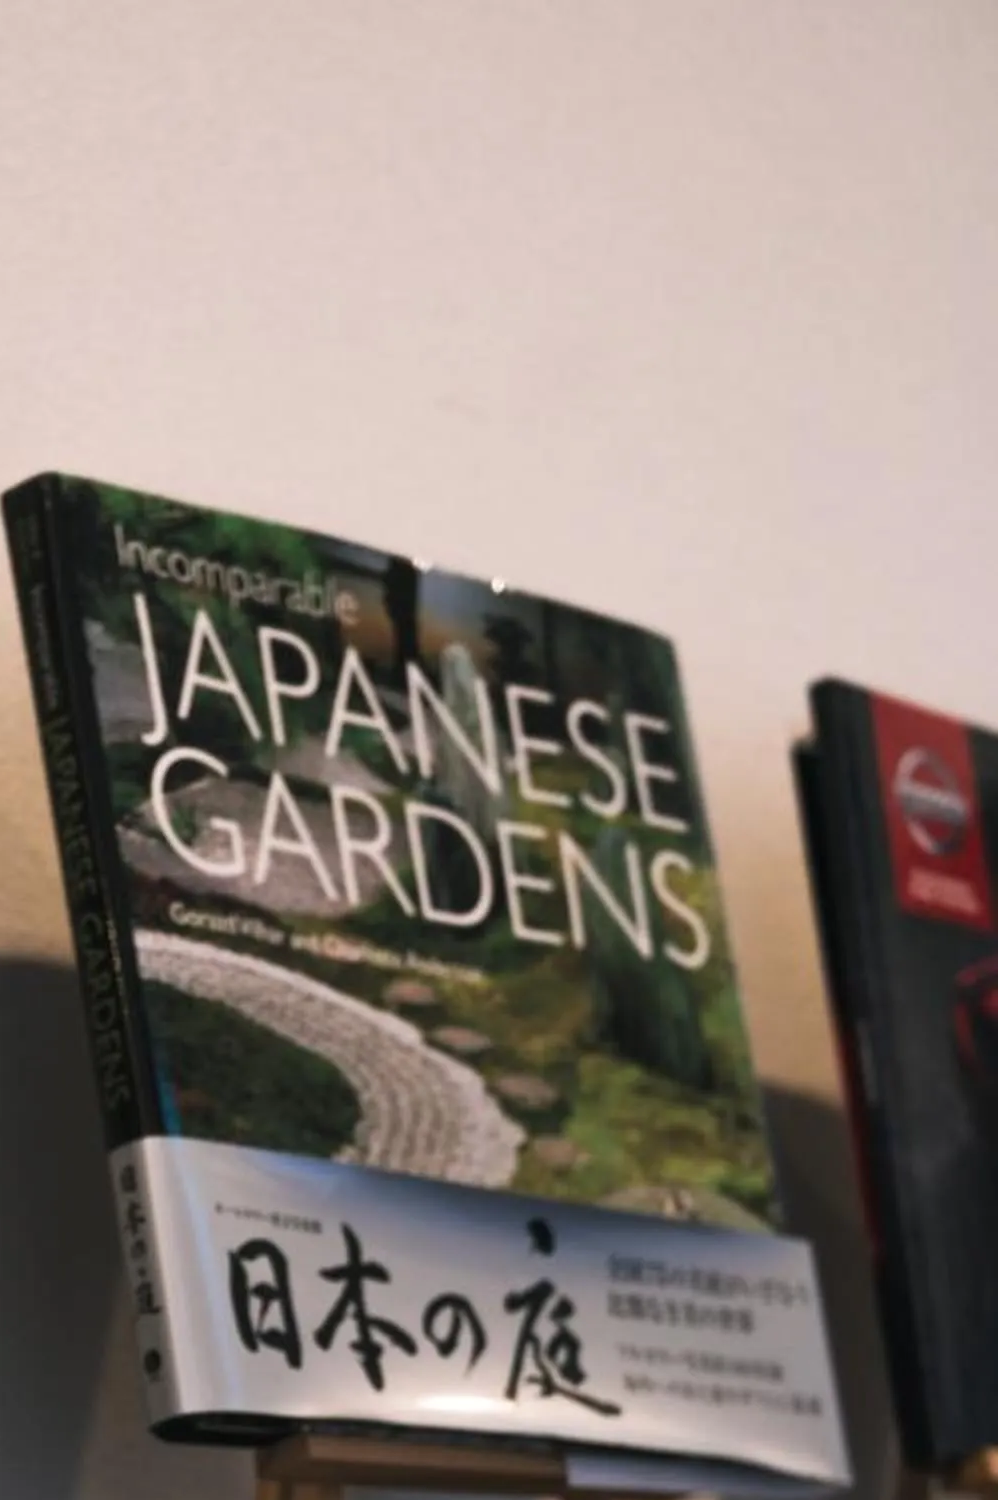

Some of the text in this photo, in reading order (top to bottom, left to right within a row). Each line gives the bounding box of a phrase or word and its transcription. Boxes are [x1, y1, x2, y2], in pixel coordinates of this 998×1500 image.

[114, 523, 360, 626] Incomparable
[133, 592, 689, 833] JAPANESE
[151, 747, 710, 970] GARDENS
[228, 1216, 622, 1417] 日本の庭
